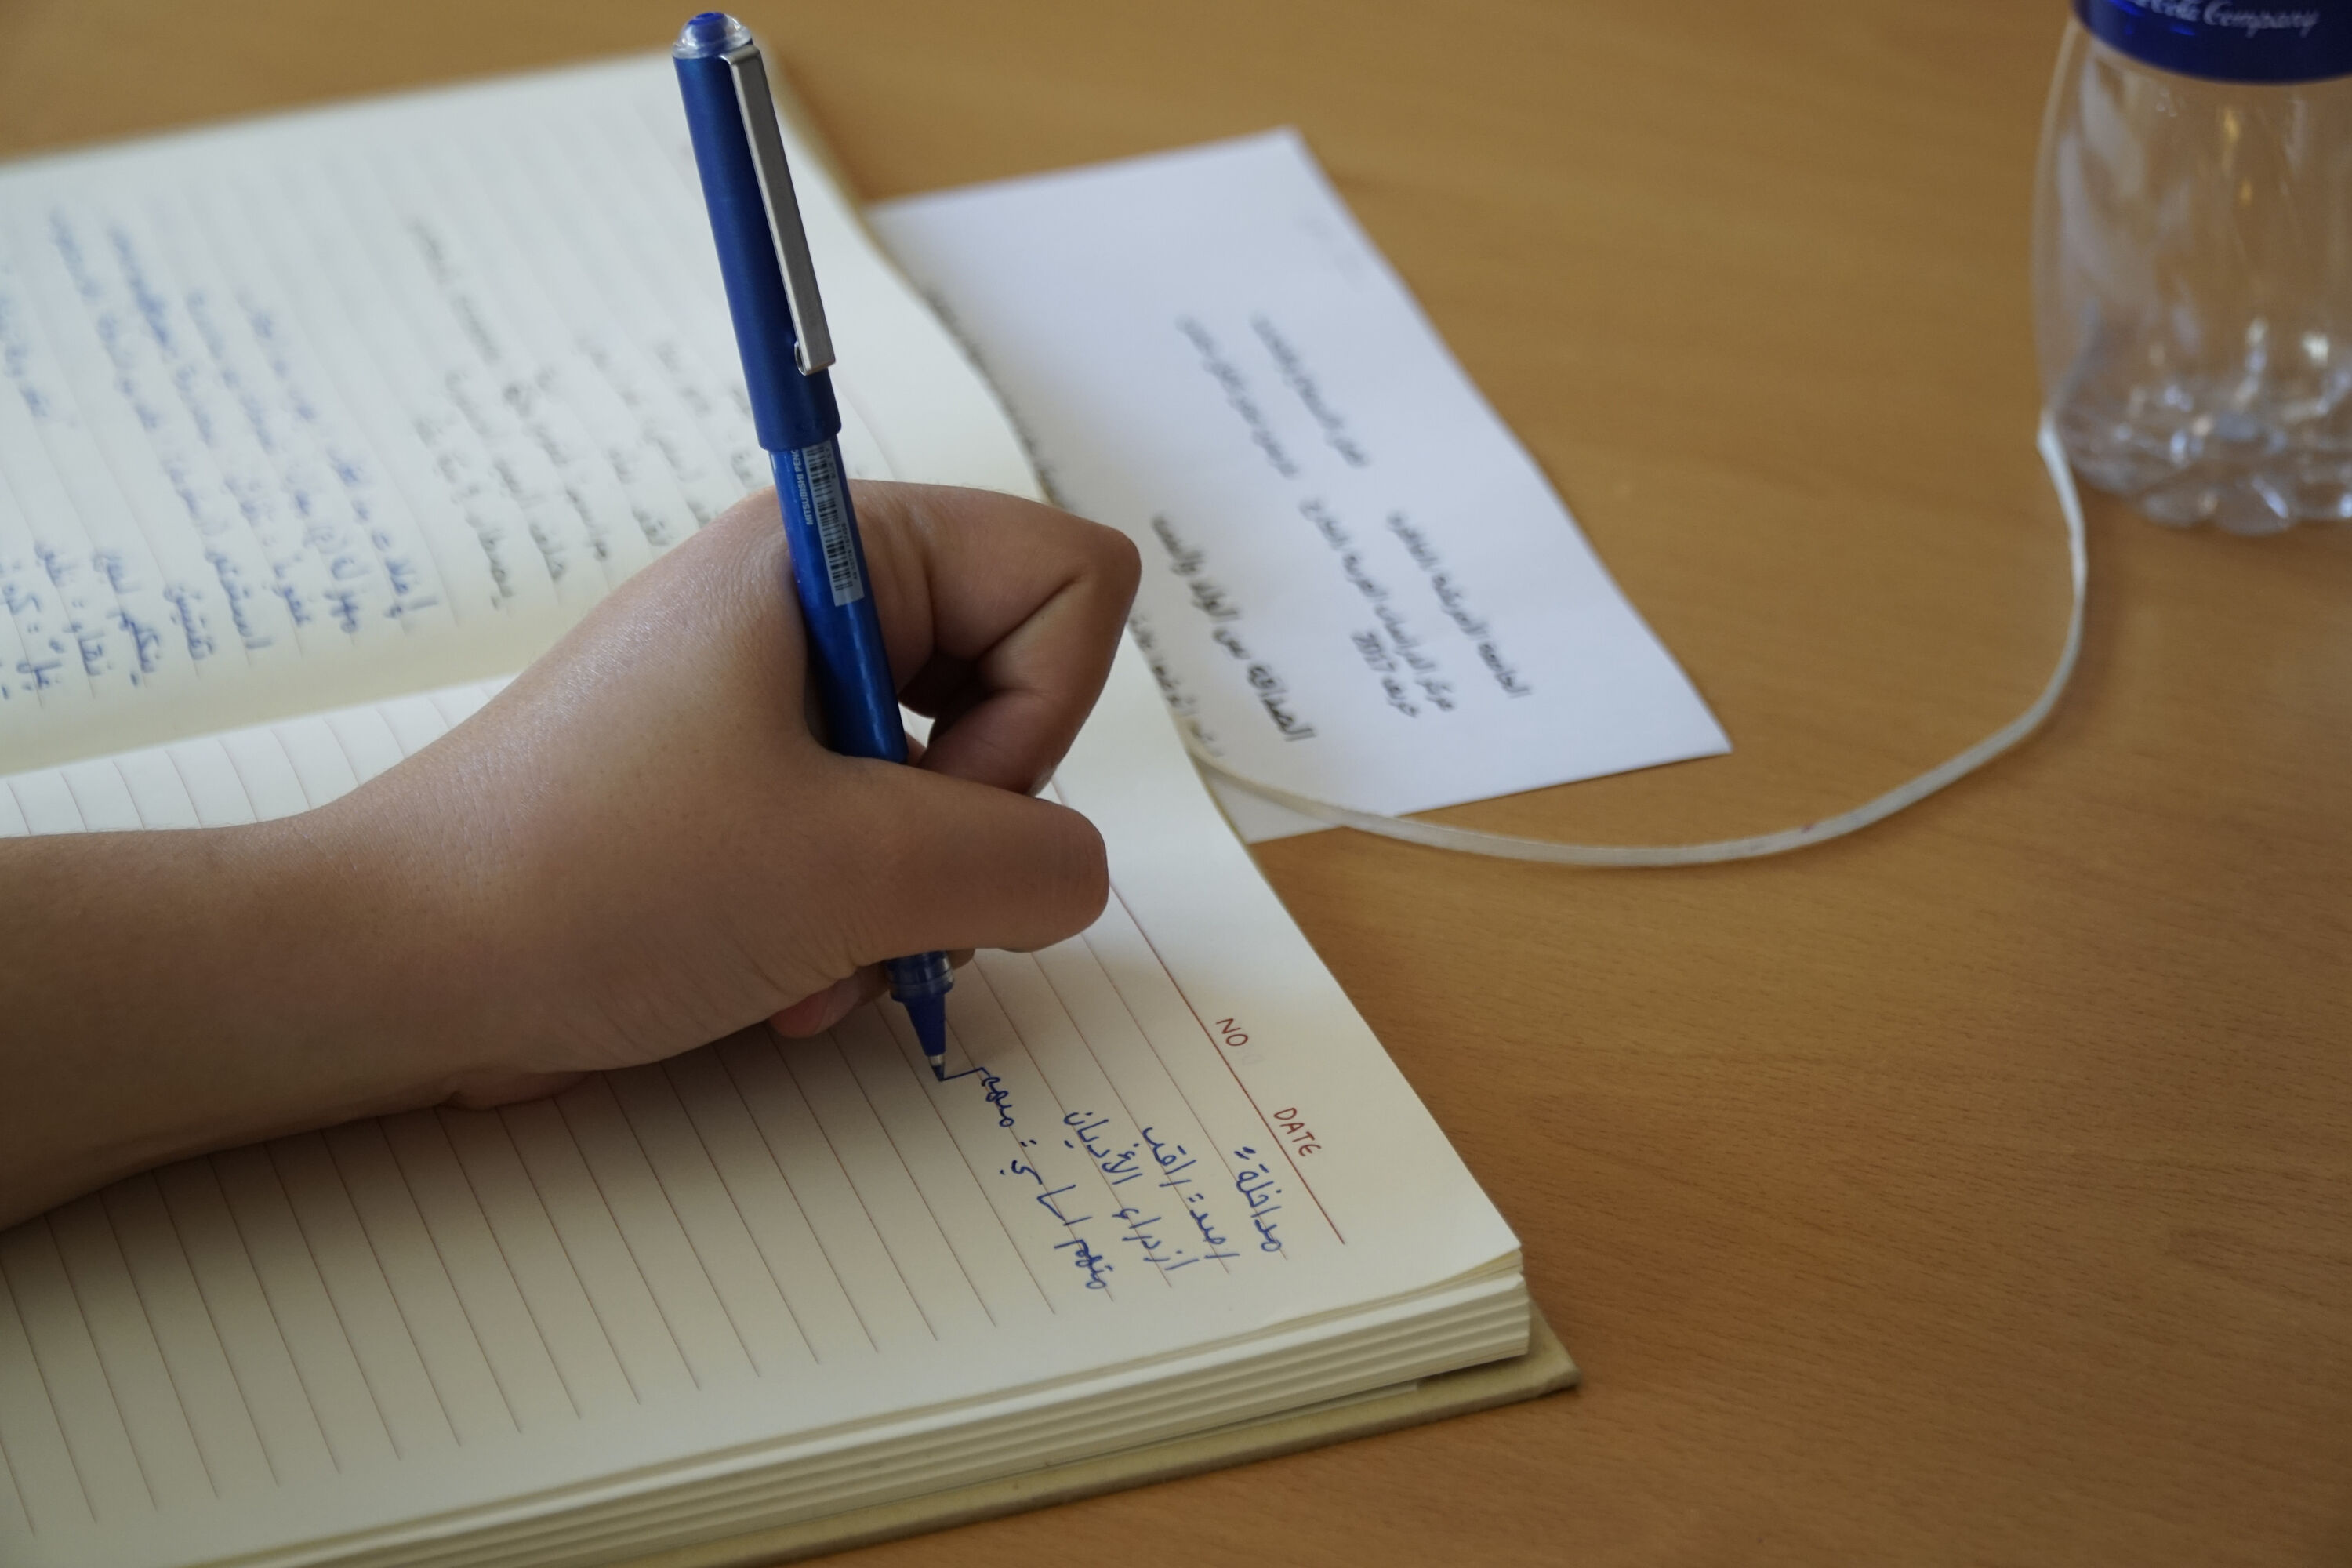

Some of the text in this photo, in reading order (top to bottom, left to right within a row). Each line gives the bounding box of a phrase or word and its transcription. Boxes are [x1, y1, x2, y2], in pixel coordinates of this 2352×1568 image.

[2203, 2, 2319, 38] Company
[796, 472, 814, 525] MITSUBISHI
[1216, 1018, 1249, 1047] NO
[1273, 1107, 1322, 1157] DATE
